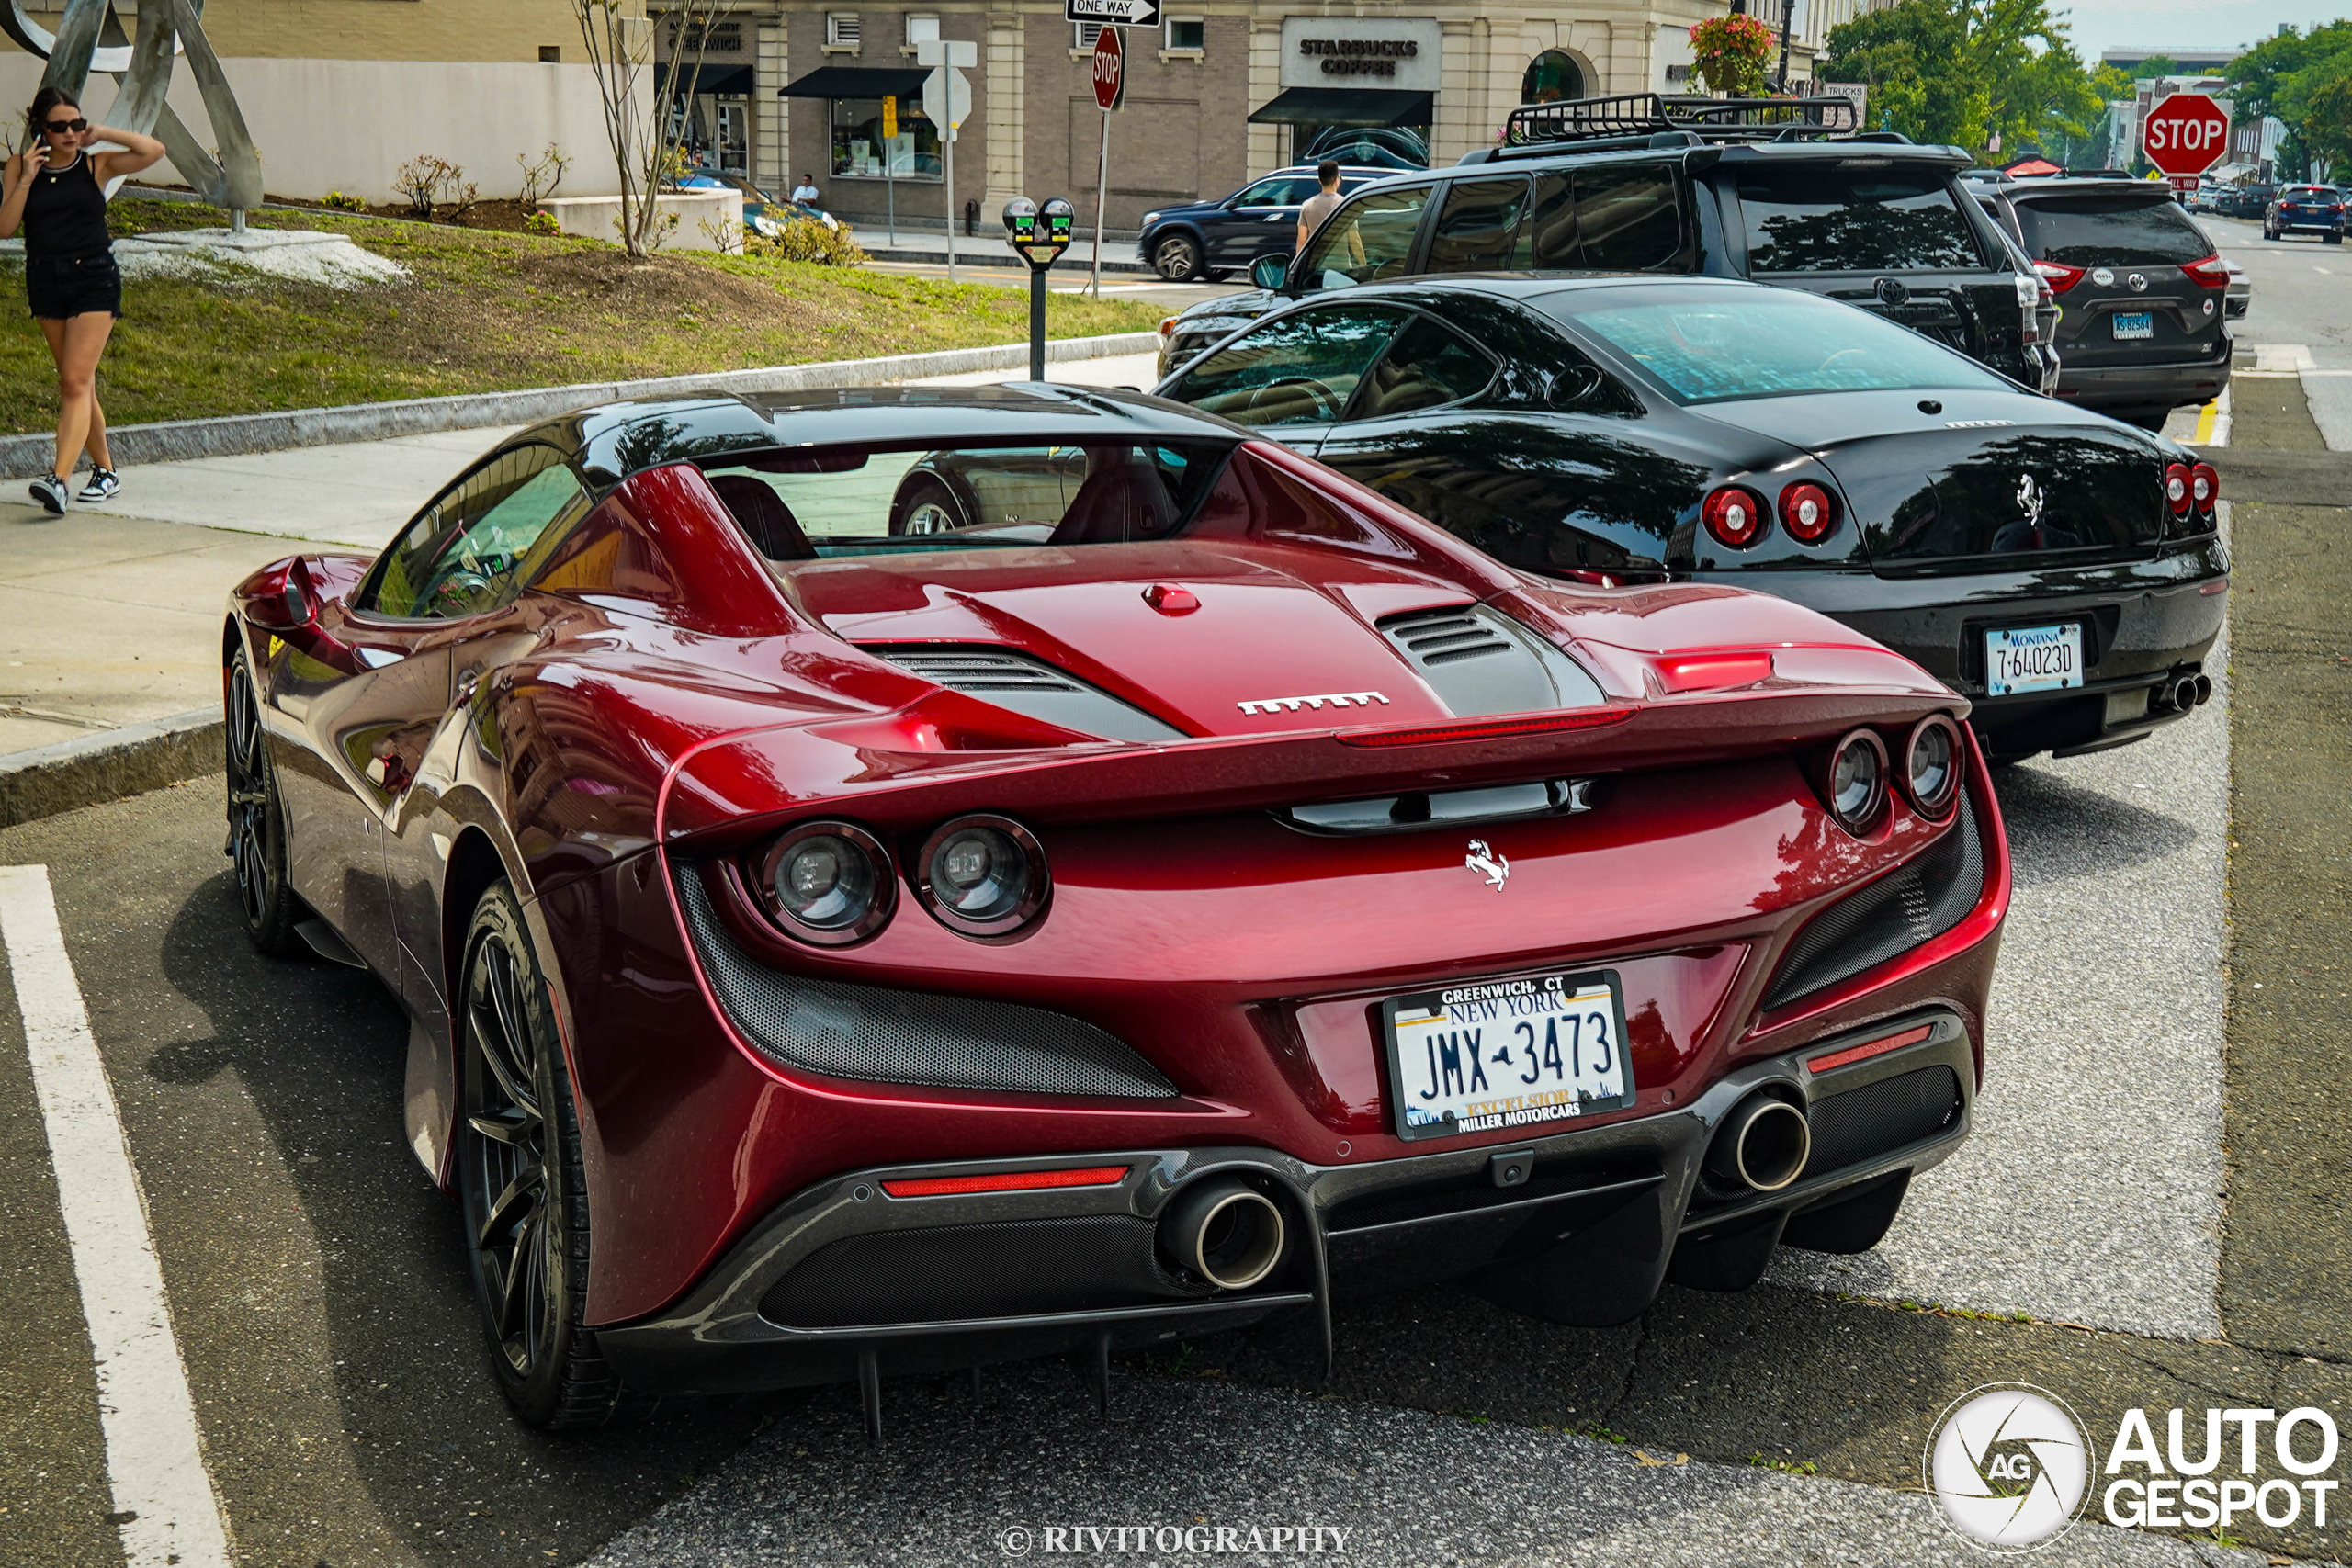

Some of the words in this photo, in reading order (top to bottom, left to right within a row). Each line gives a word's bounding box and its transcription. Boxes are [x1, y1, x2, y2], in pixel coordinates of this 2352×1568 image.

[1077, 0, 1102, 12] ONE
[1106, 0, 1132, 14] WAY
[1300, 39, 1418, 56] STARBUCKS
[1094, 51, 1119, 85] STOP
[1320, 59, 1396, 75] COFFEE
[1828, 86, 1862, 96] TRUCKS
[2149, 118, 2223, 150] STOP
[2183, 179, 2197, 188] WAY
[1442, 980, 1537, 1005] GREENWICH,
[1544, 976, 1564, 991] CT
[1448, 999, 1500, 1026] NEW
[1507, 991, 1566, 1017] YORK
[1465, 1089, 1572, 1117] EXCELSIOR
[1458, 1113, 1504, 1134] MILLER
[1505, 1103, 1581, 1125] MOTORCARS
